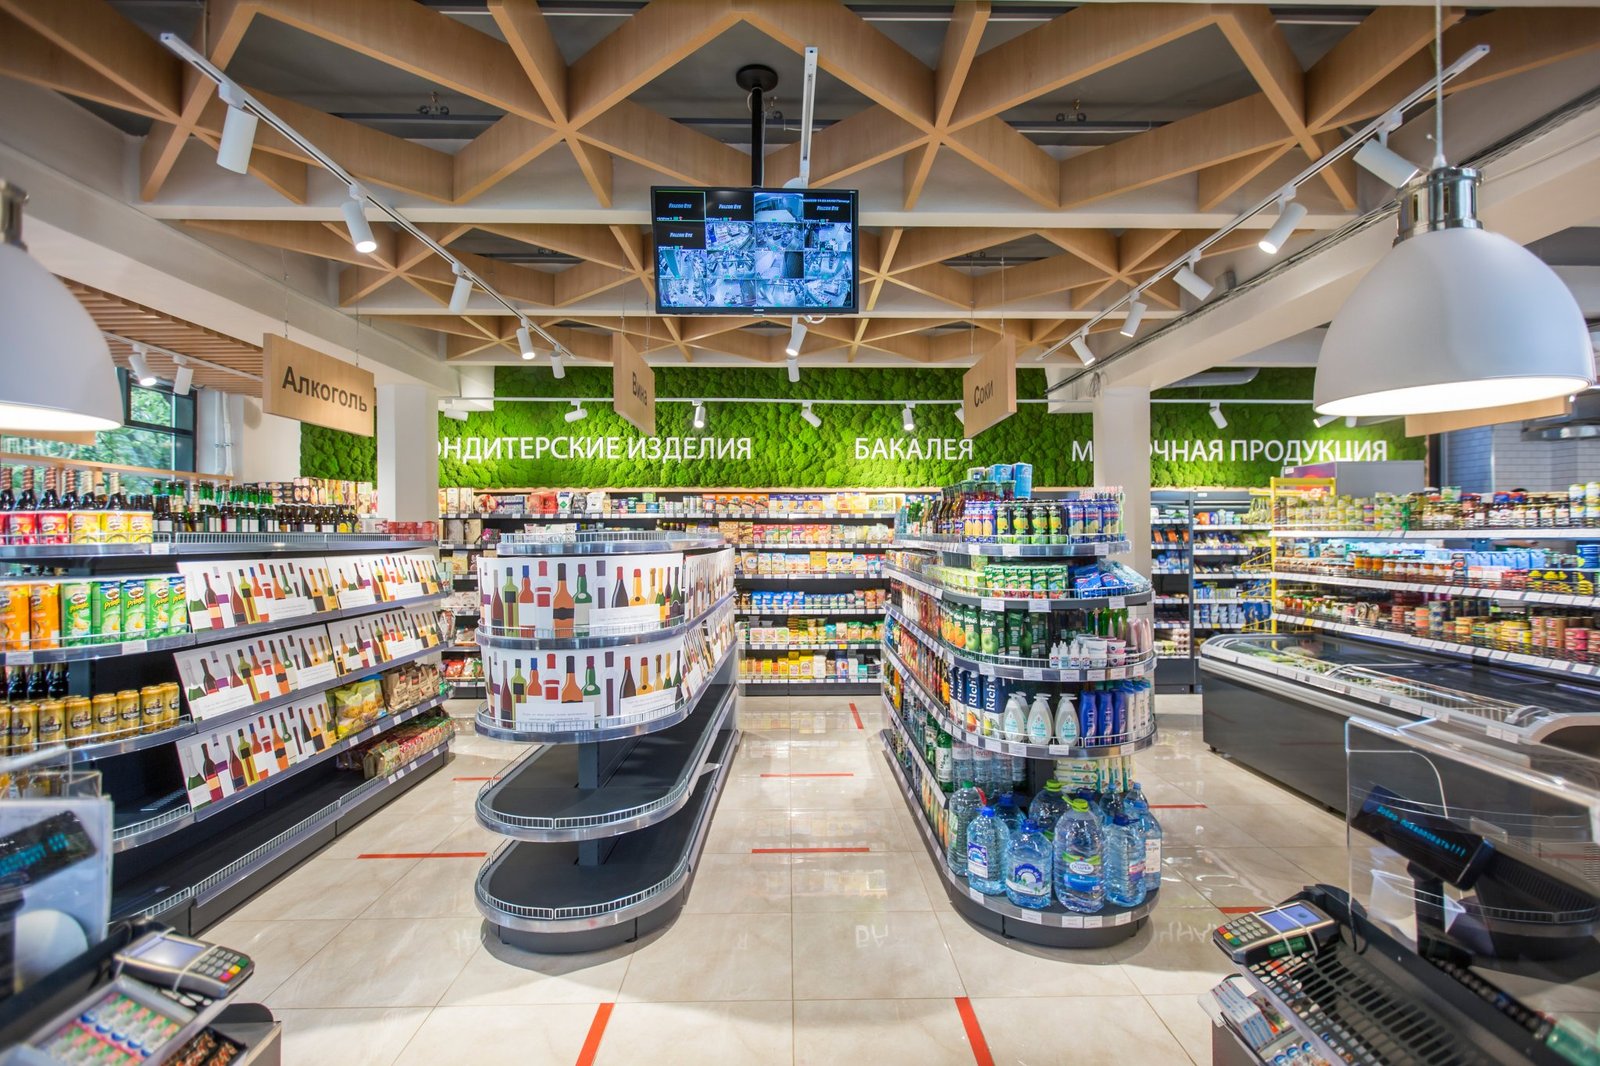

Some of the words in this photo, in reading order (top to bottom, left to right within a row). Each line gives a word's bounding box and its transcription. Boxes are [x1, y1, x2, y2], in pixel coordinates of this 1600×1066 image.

[282, 366, 368, 412] Алкоголь
[632, 371, 648, 406] Вина
[974, 380, 994, 408] Соки
[438, 436, 620, 465] НДИТЕРСКИЕ
[627, 436, 751, 464] ИЗДЕЛИЯ
[855, 437, 974, 460] БАКАЛЕЯ
[1071, 439, 1223, 462] МЧНАЯ
[1230, 439, 1388, 466] ПРОДУКЦИЯ
[968, 681, 977, 706] Rich
[986, 683, 996, 711] Rich
